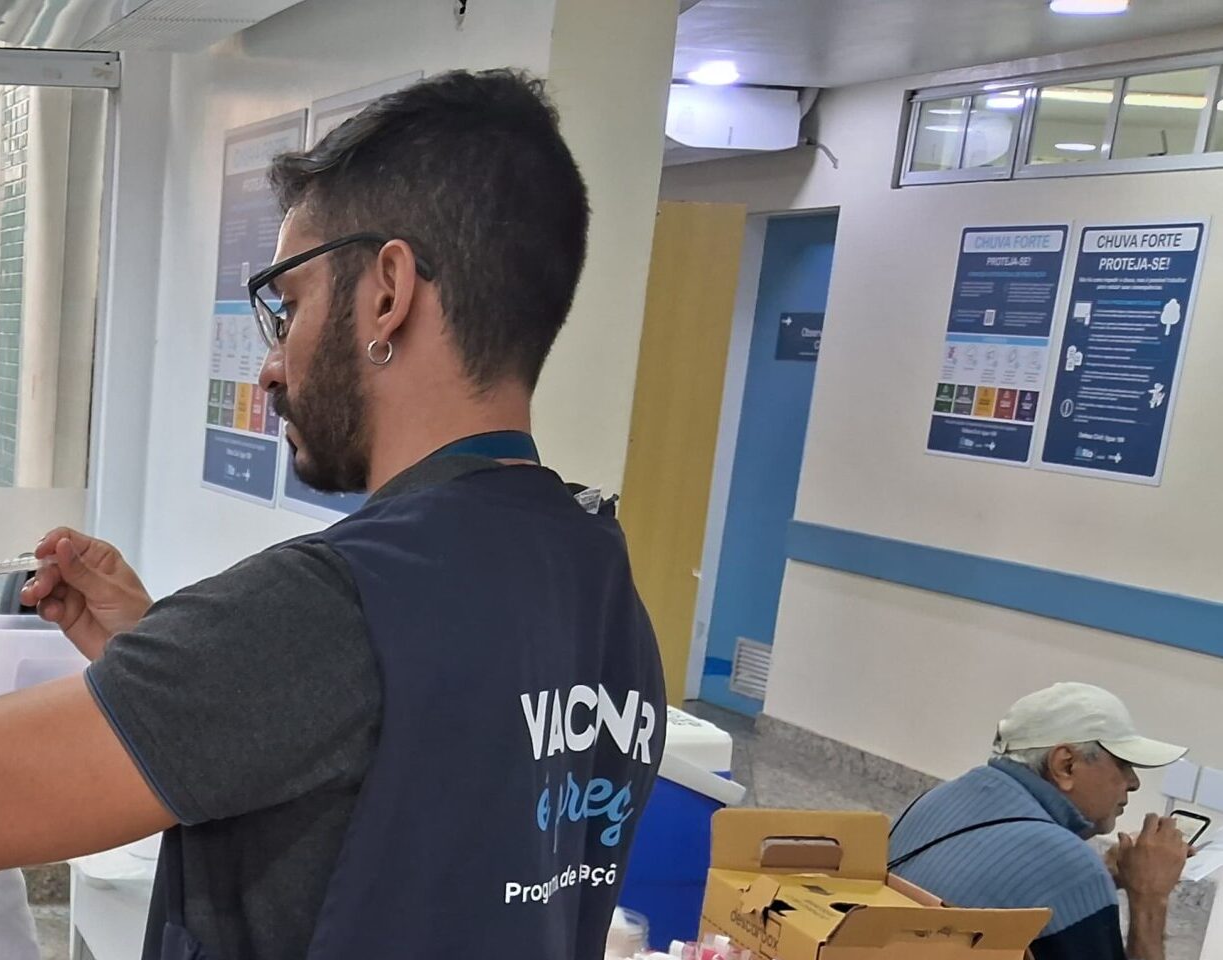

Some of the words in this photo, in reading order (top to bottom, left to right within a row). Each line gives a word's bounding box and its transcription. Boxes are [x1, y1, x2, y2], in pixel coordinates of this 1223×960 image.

[974, 235, 1011, 249] CHUVA
[1014, 234, 1051, 249] FORTE
[1097, 234, 1138, 249] CHUVA
[1140, 233, 1182, 248] FORTE
[1098, 257, 1171, 271] PROTEJA-SE!
[560, 864, 577, 887] de
